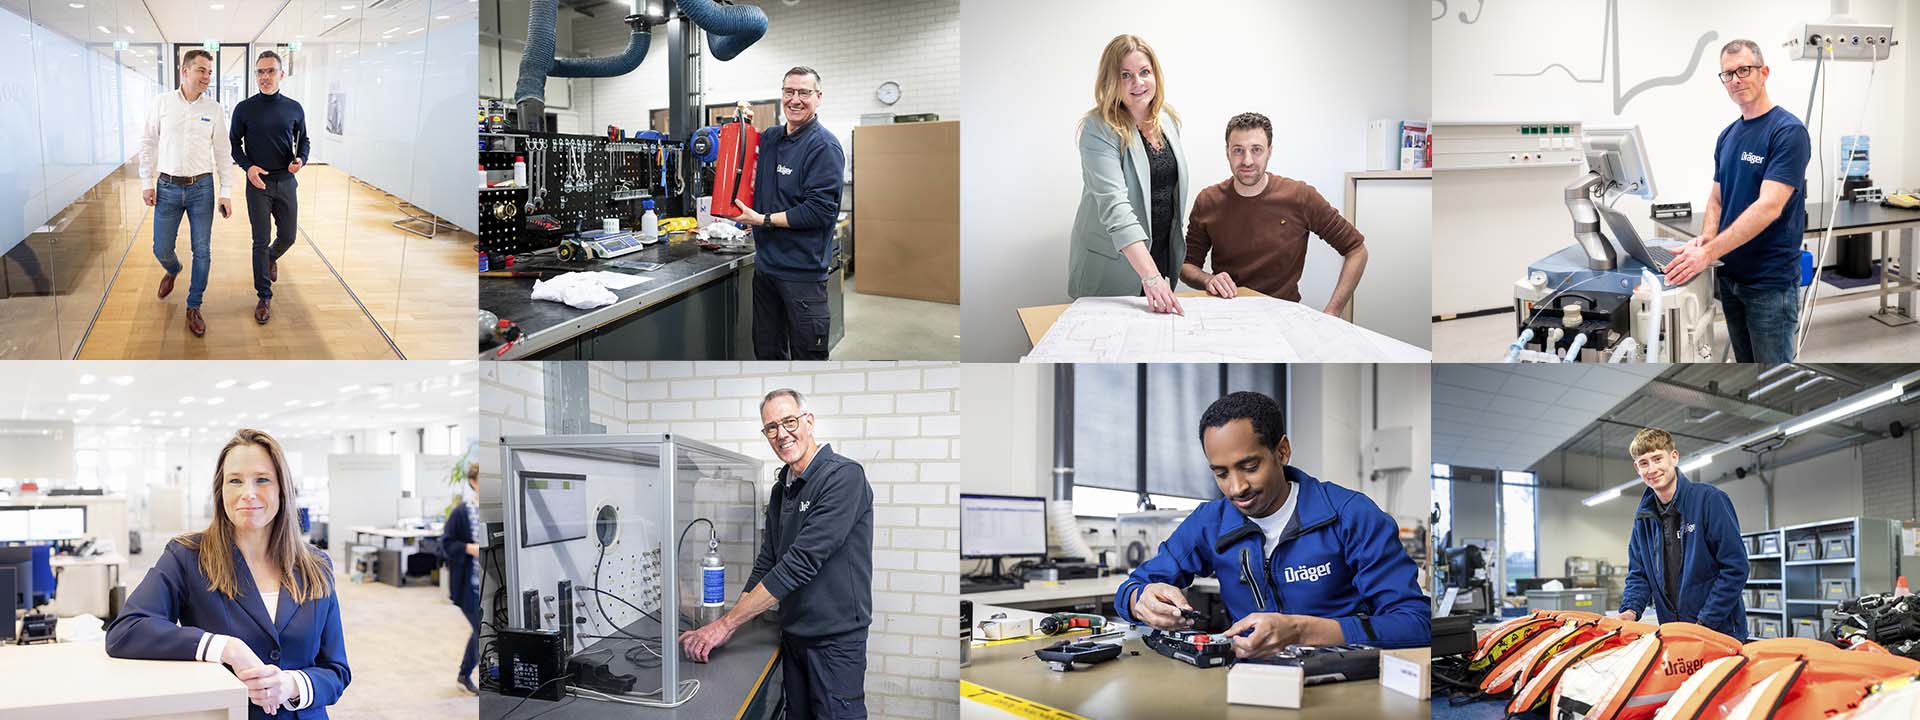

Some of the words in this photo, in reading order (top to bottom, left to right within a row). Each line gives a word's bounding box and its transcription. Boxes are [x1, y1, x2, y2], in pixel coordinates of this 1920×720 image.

[1740, 151, 1765, 164] Dräger
[1284, 561, 1332, 583] Dräger
[1664, 657, 1705, 676] Dräger
